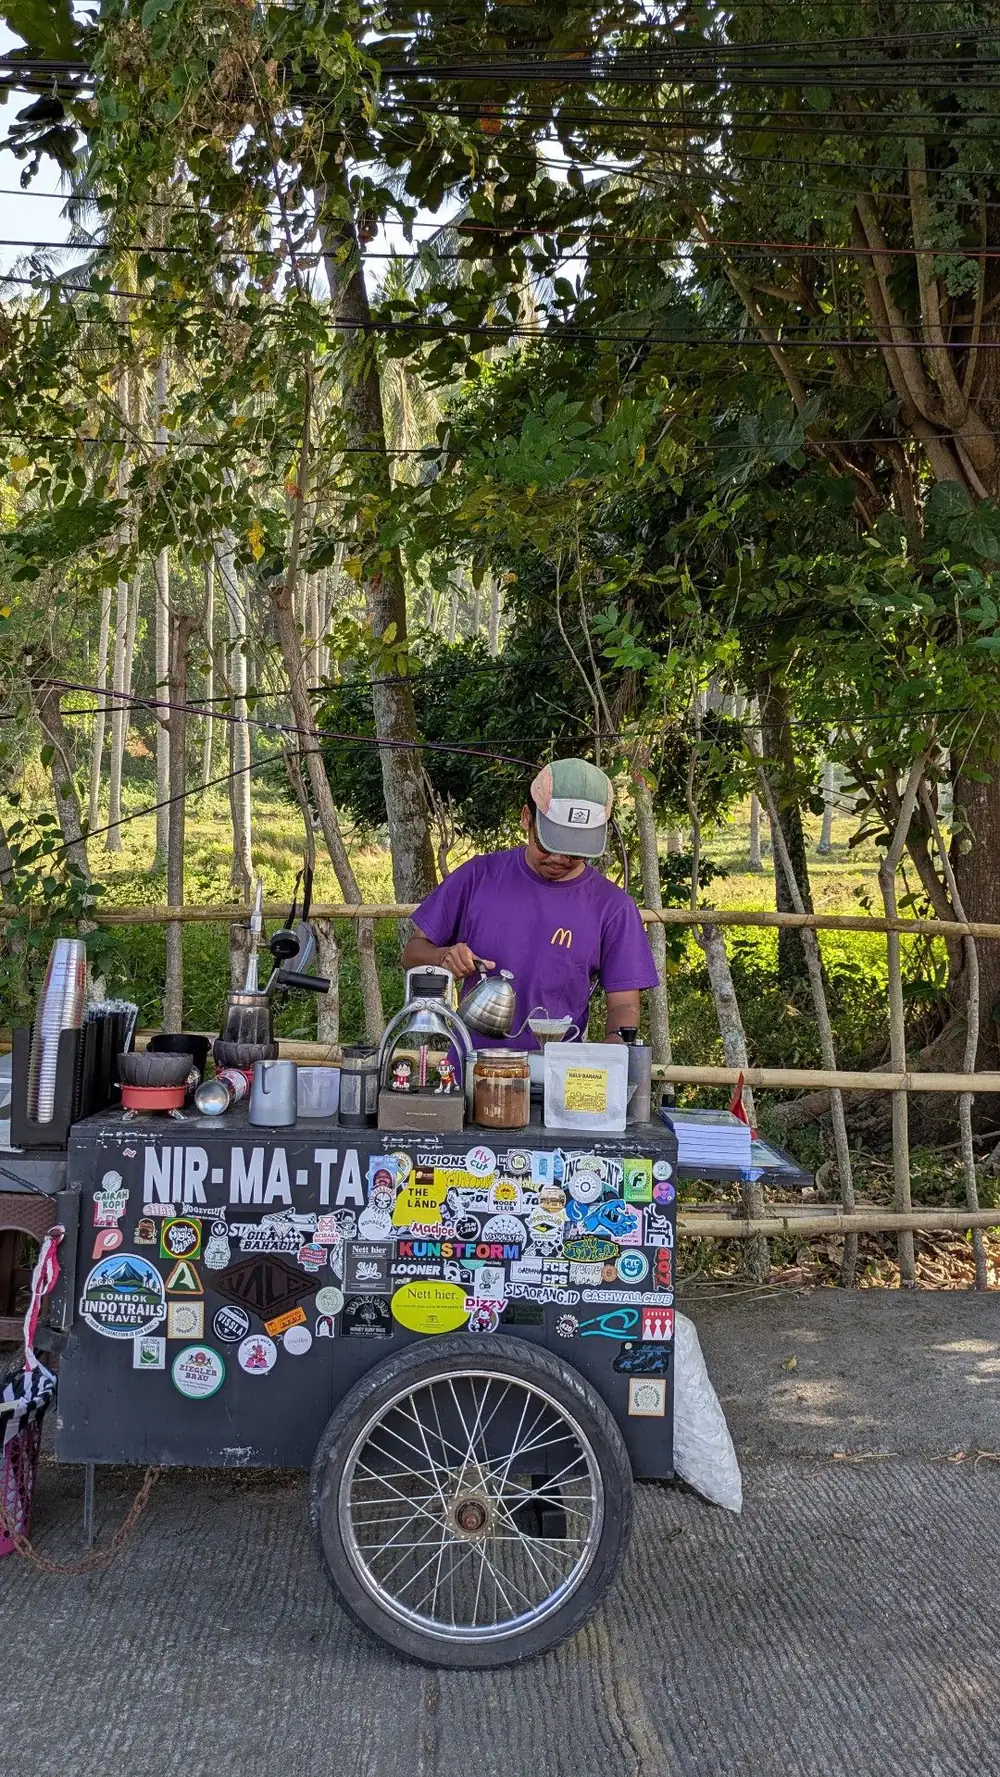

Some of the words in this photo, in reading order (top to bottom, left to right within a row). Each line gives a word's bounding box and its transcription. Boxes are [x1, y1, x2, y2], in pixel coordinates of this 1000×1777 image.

[418, 1154, 466, 1166] VISIONS
[475, 1149, 491, 1163] fly
[470, 1159, 489, 1171] cut
[408, 1188, 429, 1197] THE
[102, 1200, 125, 1209] KOPI
[407, 1197, 438, 1209] LÄND
[411, 1220, 455, 1238] Madjoe
[352, 1245, 369, 1254] Nett
[371, 1245, 387, 1254] hier
[399, 1241, 519, 1259] KUNSTFORM
[390, 1263, 441, 1276] LOONER
[543, 1262, 569, 1273] FCK
[542, 1274, 568, 1285] CPS
[101, 1293, 147, 1303] LOMBOK
[408, 1288, 431, 1300] Nett
[435, 1288, 459, 1300] hier.
[583, 1291, 641, 1303] CASHWALL
[642, 1294, 673, 1304] CLUB
[85, 1300, 117, 1314] INDO
[119, 1303, 163, 1317] TRAILS
[465, 1296, 507, 1310] Dizzy
[101, 1313, 143, 1324] TRAVEL
[216, 1312, 244, 1336] VISSLA
[560, 1322, 574, 1332] 420
[179, 1364, 217, 1377] ZIEGLER
